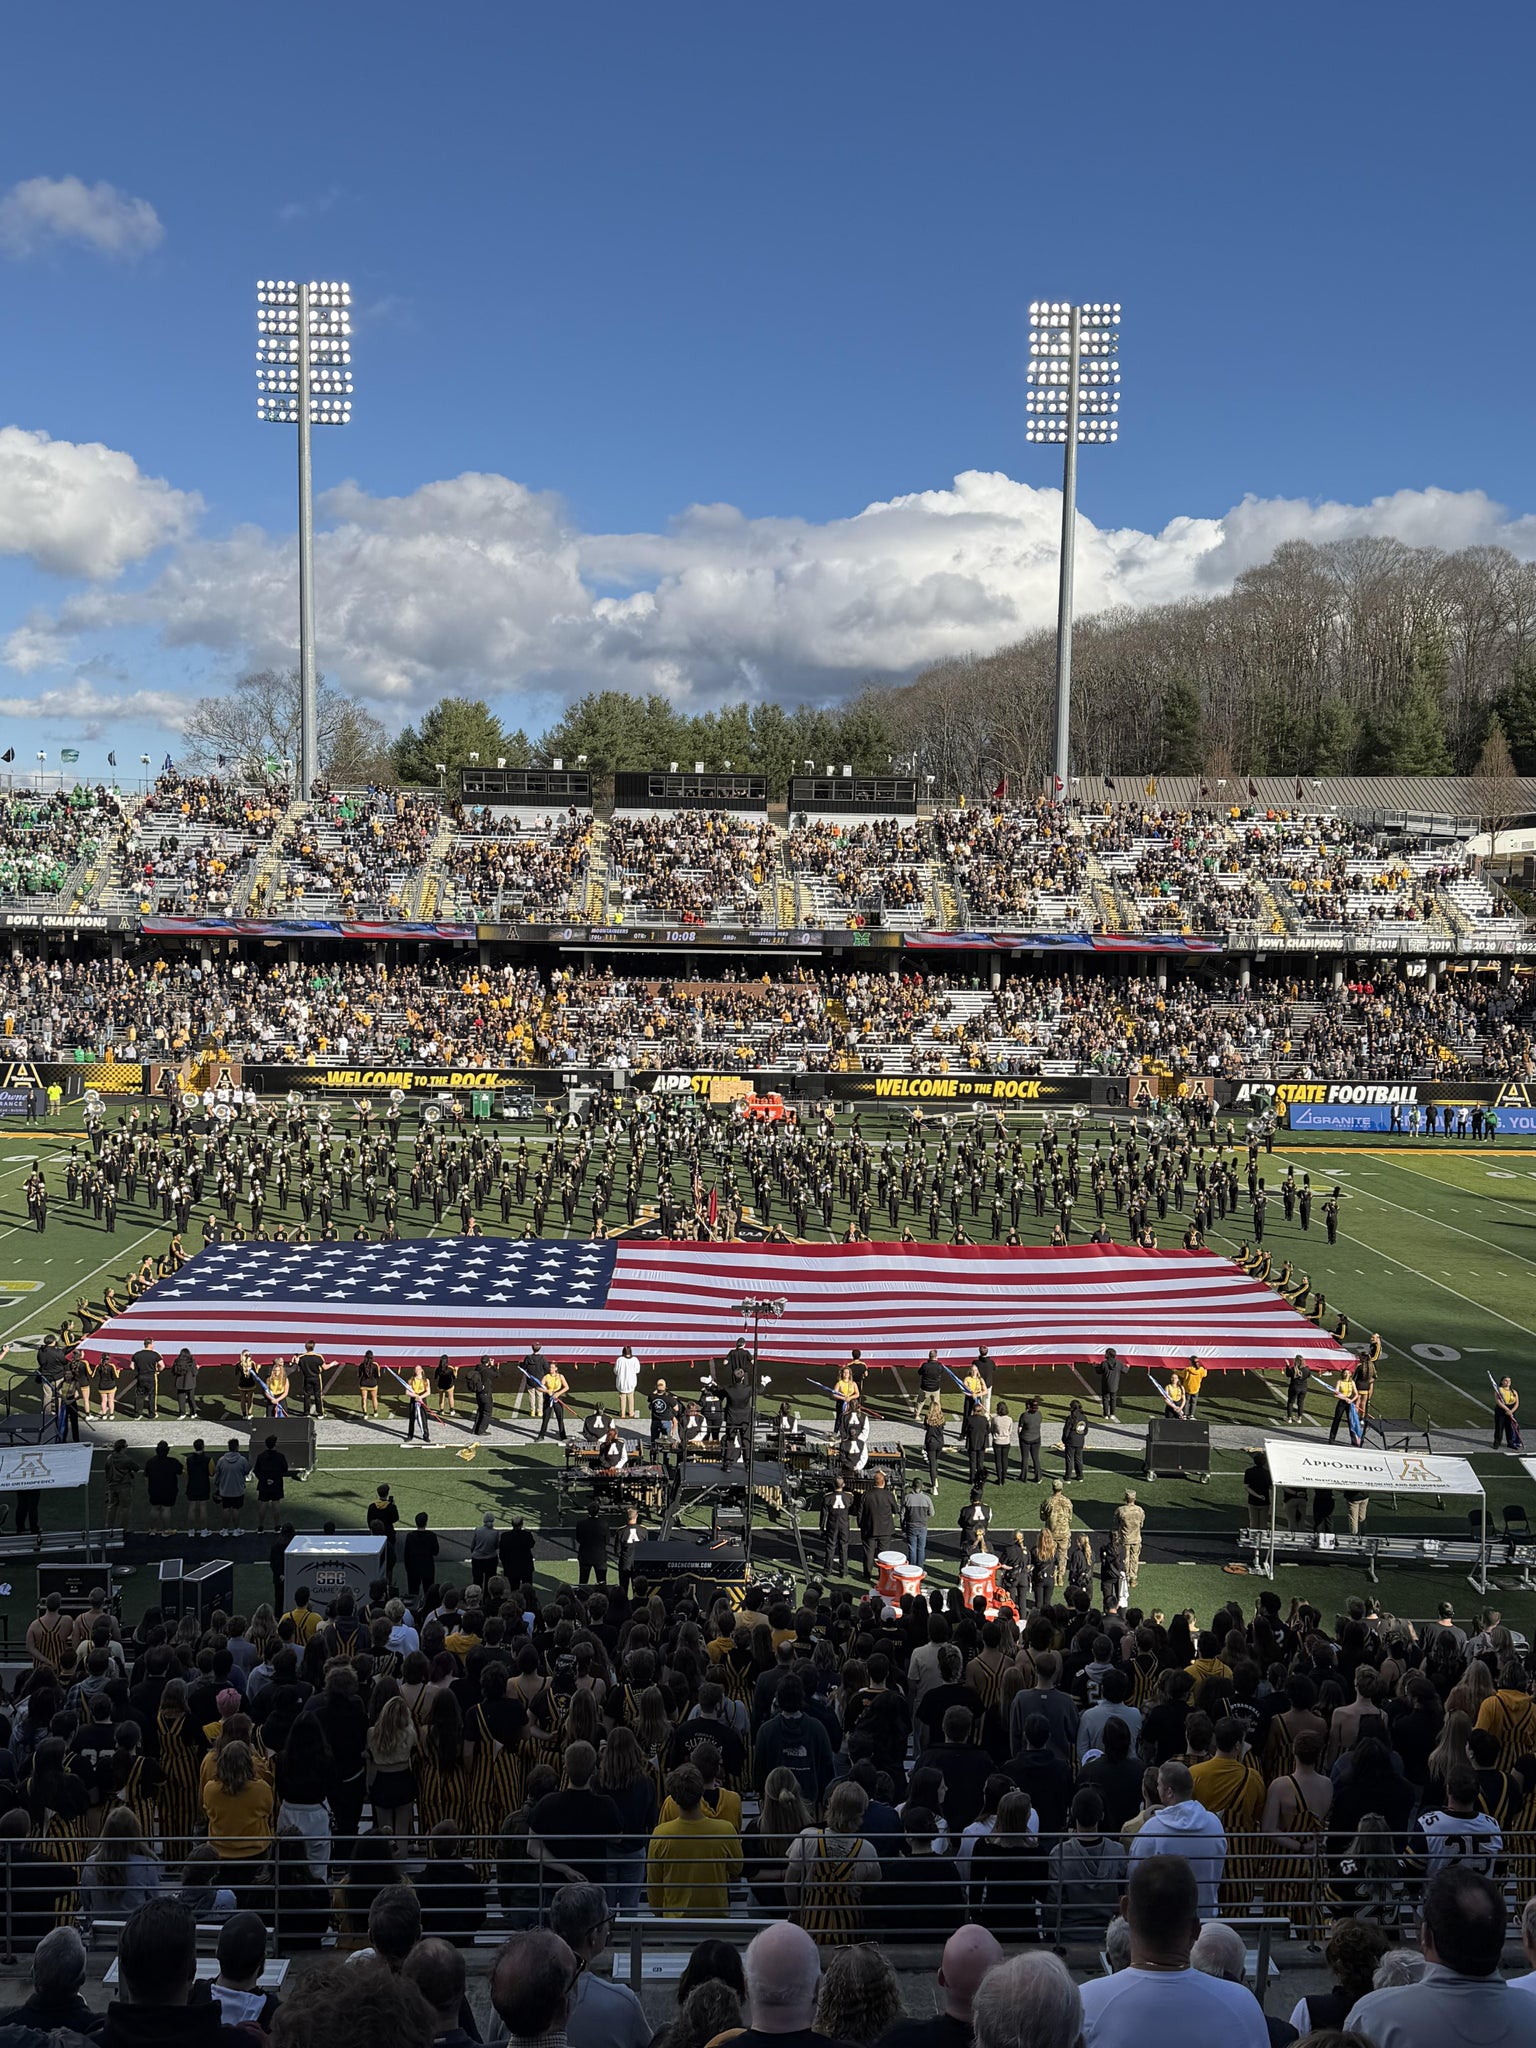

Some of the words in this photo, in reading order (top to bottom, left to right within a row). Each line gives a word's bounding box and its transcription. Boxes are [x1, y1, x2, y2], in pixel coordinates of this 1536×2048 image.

[6, 915, 39, 925] BOWL
[42, 916, 108, 927] CHAMPIONS
[118, 916, 131, 929] A
[507, 926, 520, 940] A
[563, 928, 573, 940] 0
[665, 931, 696, 941] 10:08
[801, 932, 811, 945] 0
[1257, 938, 1284, 948] BOWL
[1286, 938, 1344, 949] CHAMPIONS
[1376, 941, 1398, 950] 2018
[1429, 941, 1451, 950] 2019
[1474, 941, 1497, 951] 2020
[327, 1071, 413, 1090] WELCOME
[414, 1075, 427, 1087] TO
[430, 1076, 449, 1086] THE
[450, 1073, 499, 1087] ROCK
[875, 1078, 959, 1097] WELCOME
[959, 1083, 972, 1094] TO
[974, 1083, 992, 1094] THE
[993, 1080, 1041, 1098] ROCK
[1276, 1084, 1327, 1103] STATE
[1328, 1085, 1418, 1104] FOOTBALL
[316, 1571, 347, 1586] SBC
[1444, 1834, 1492, 1877] 25
